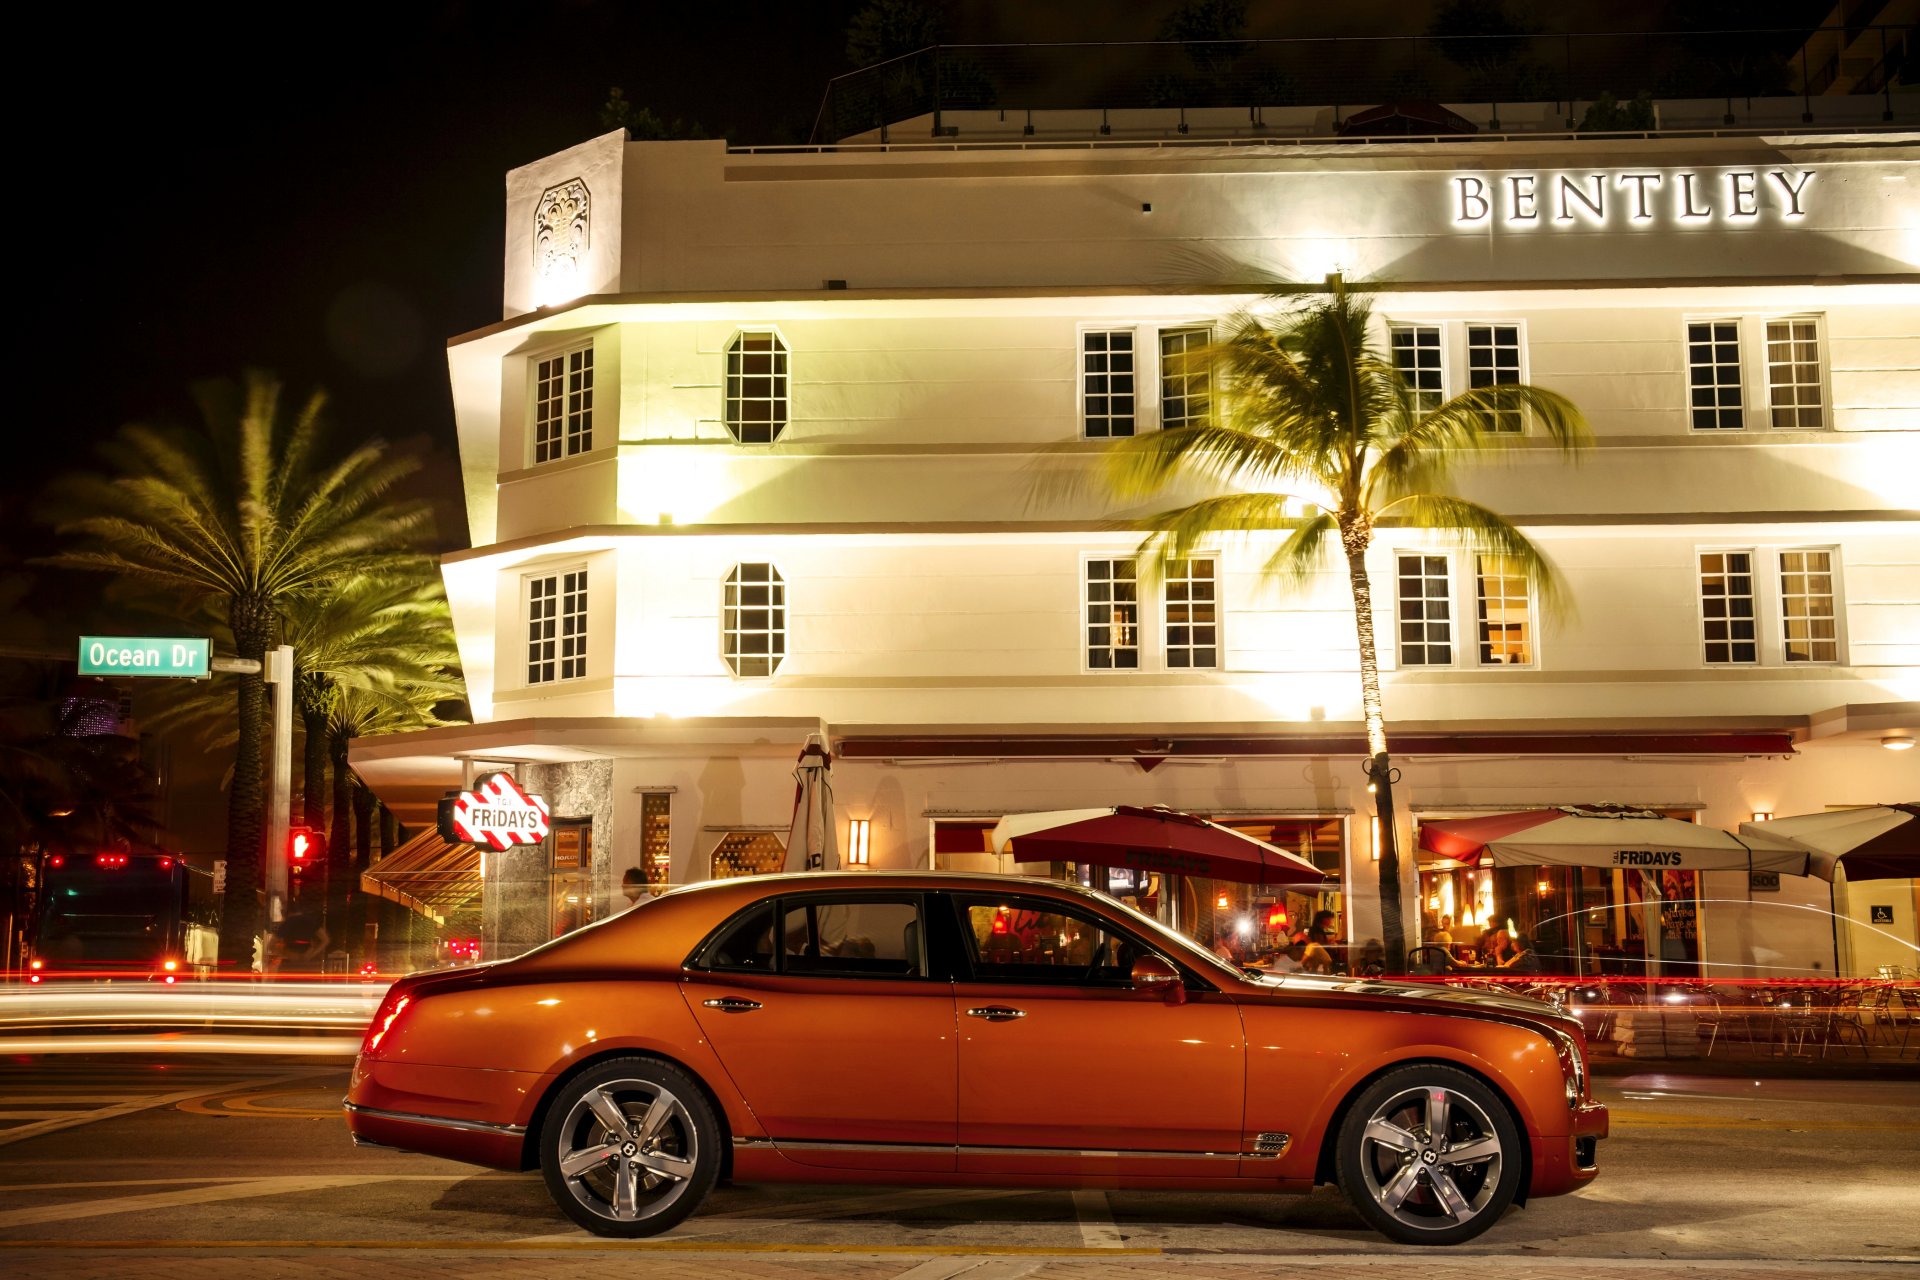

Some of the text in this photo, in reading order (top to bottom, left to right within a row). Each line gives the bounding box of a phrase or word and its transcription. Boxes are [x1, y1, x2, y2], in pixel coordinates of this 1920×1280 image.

[1455, 171, 1816, 221] BENTLEY
[90, 642, 197, 667] Ocean Dr
[1752, 876, 1780, 887] 500
